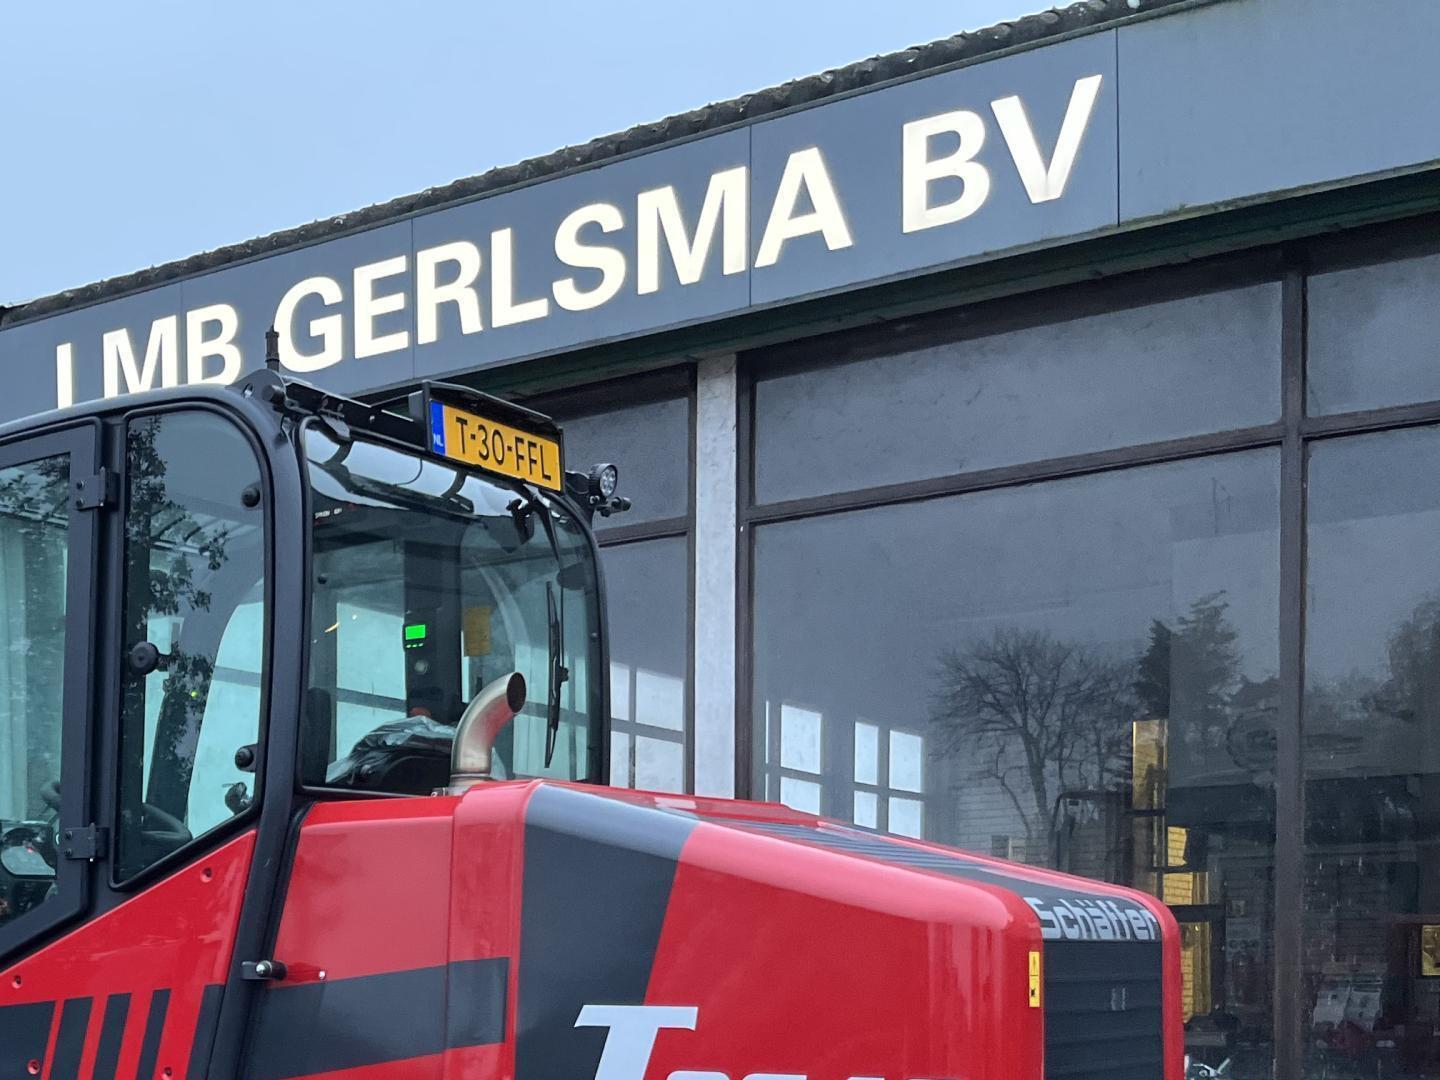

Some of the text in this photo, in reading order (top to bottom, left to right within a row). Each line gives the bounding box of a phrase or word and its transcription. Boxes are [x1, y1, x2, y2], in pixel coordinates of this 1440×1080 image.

[273, 146, 853, 373] GERLSMA
[902, 74, 1103, 234] BV
[432, 432, 444, 448] NL
[455, 416, 552, 481] T-30-FFL
[1024, 897, 1157, 940] Schäffer
